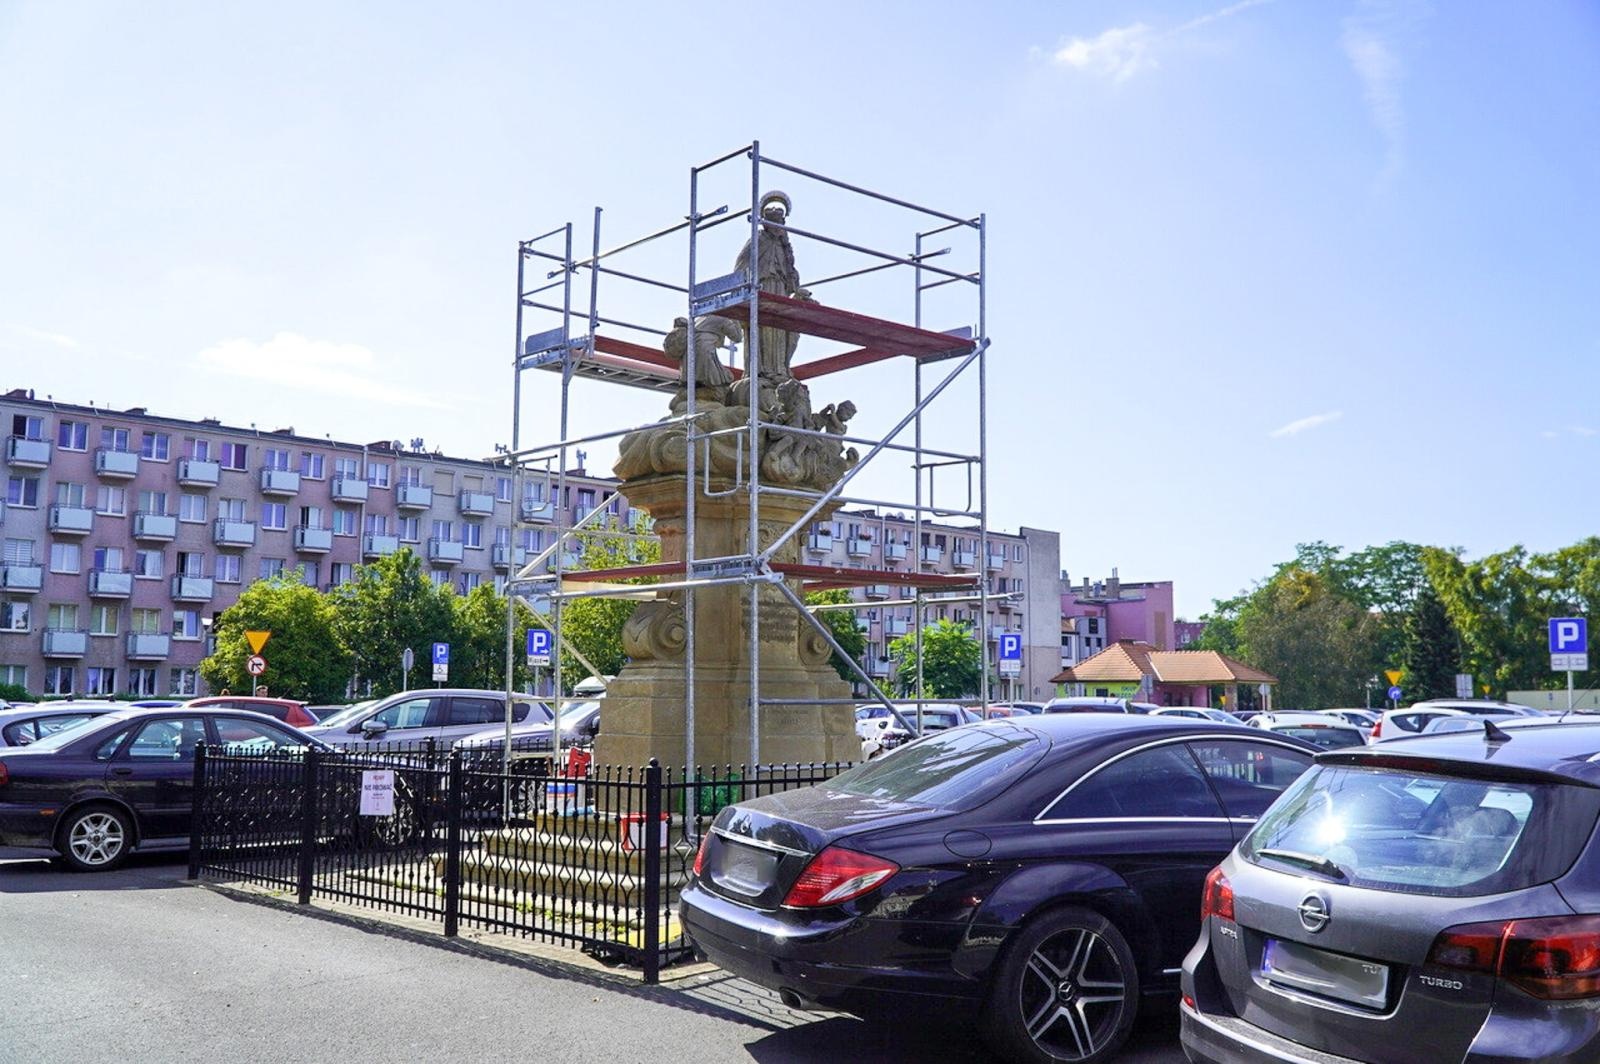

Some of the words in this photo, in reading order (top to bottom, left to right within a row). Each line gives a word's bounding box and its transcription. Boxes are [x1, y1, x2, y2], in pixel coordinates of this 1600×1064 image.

[533, 632, 547, 653] P
[1557, 622, 1579, 649] P
[436, 645, 446, 658] P
[1004, 637, 1017, 657] P
[1419, 975, 1463, 990] TURBO
